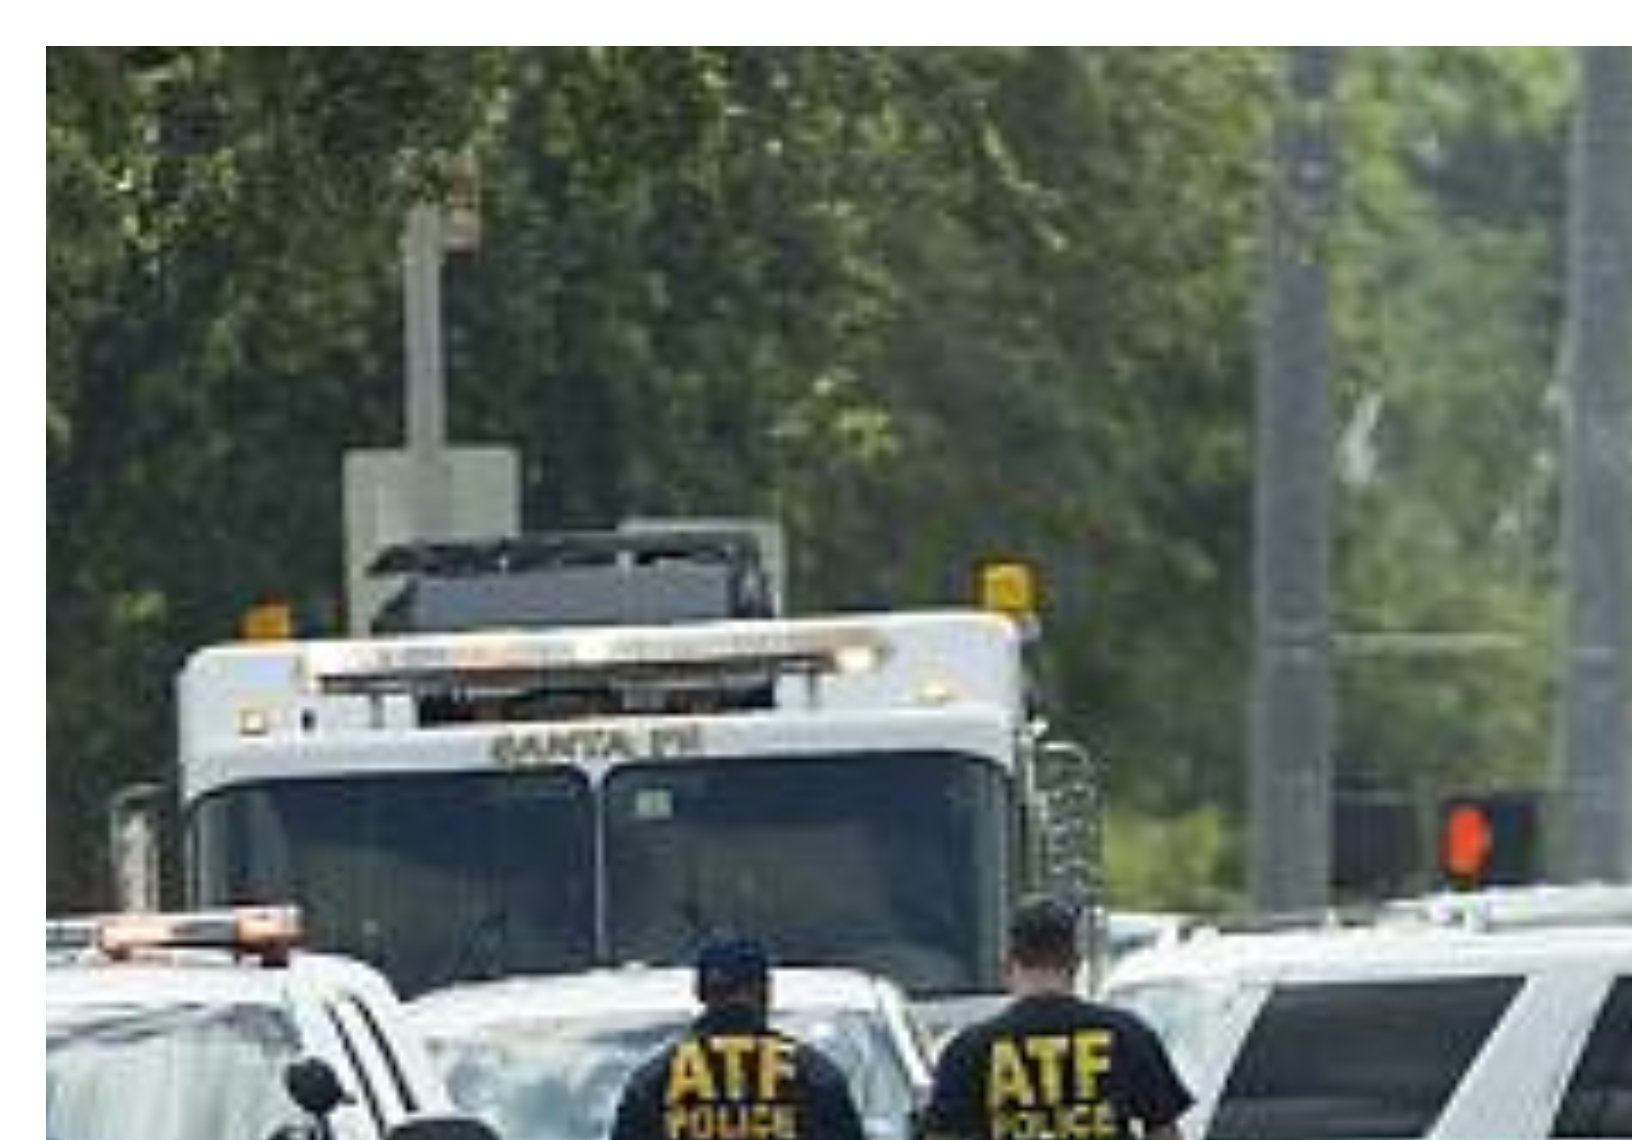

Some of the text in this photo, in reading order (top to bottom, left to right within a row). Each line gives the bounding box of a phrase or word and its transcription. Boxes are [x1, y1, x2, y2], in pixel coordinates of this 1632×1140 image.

[491, 728, 633, 767] SANTA
[665, 1033, 798, 1101] ATF
[986, 1028, 1113, 1104] ATF
